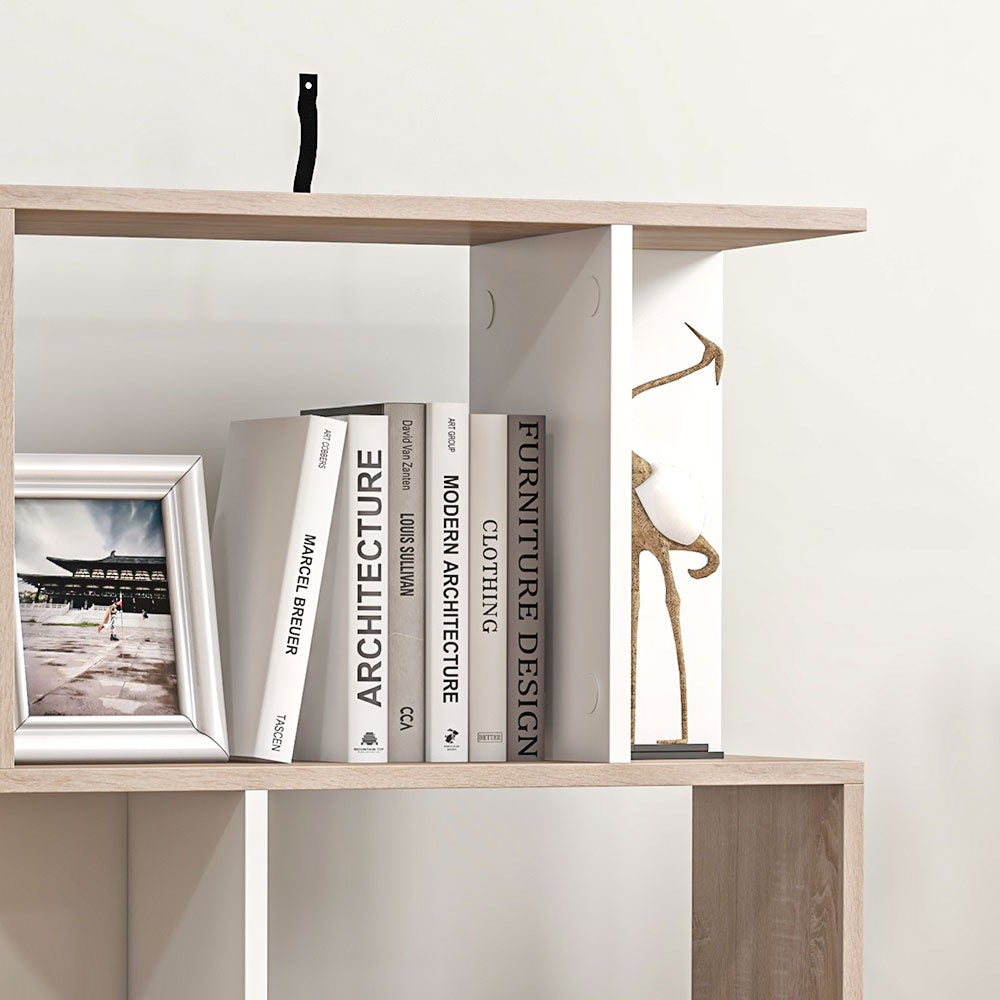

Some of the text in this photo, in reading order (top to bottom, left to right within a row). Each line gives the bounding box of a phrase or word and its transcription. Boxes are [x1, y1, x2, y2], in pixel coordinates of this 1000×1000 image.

[402, 419, 413, 491] David Van Zanten
[448, 417, 456, 453] ART GROUP
[285, 533, 317, 656] MARCEL BREUER
[357, 450, 382, 708] ARCHITECTURE
[400, 513, 414, 597] LOUIS SULLIVAN
[443, 475, 459, 703] MODERN ARCHITECTURE
[482, 519, 498, 634] CLOTHING
[517, 420, 539, 758] FURNITURE DESIGN
[271, 714, 287, 753] TASCEN
